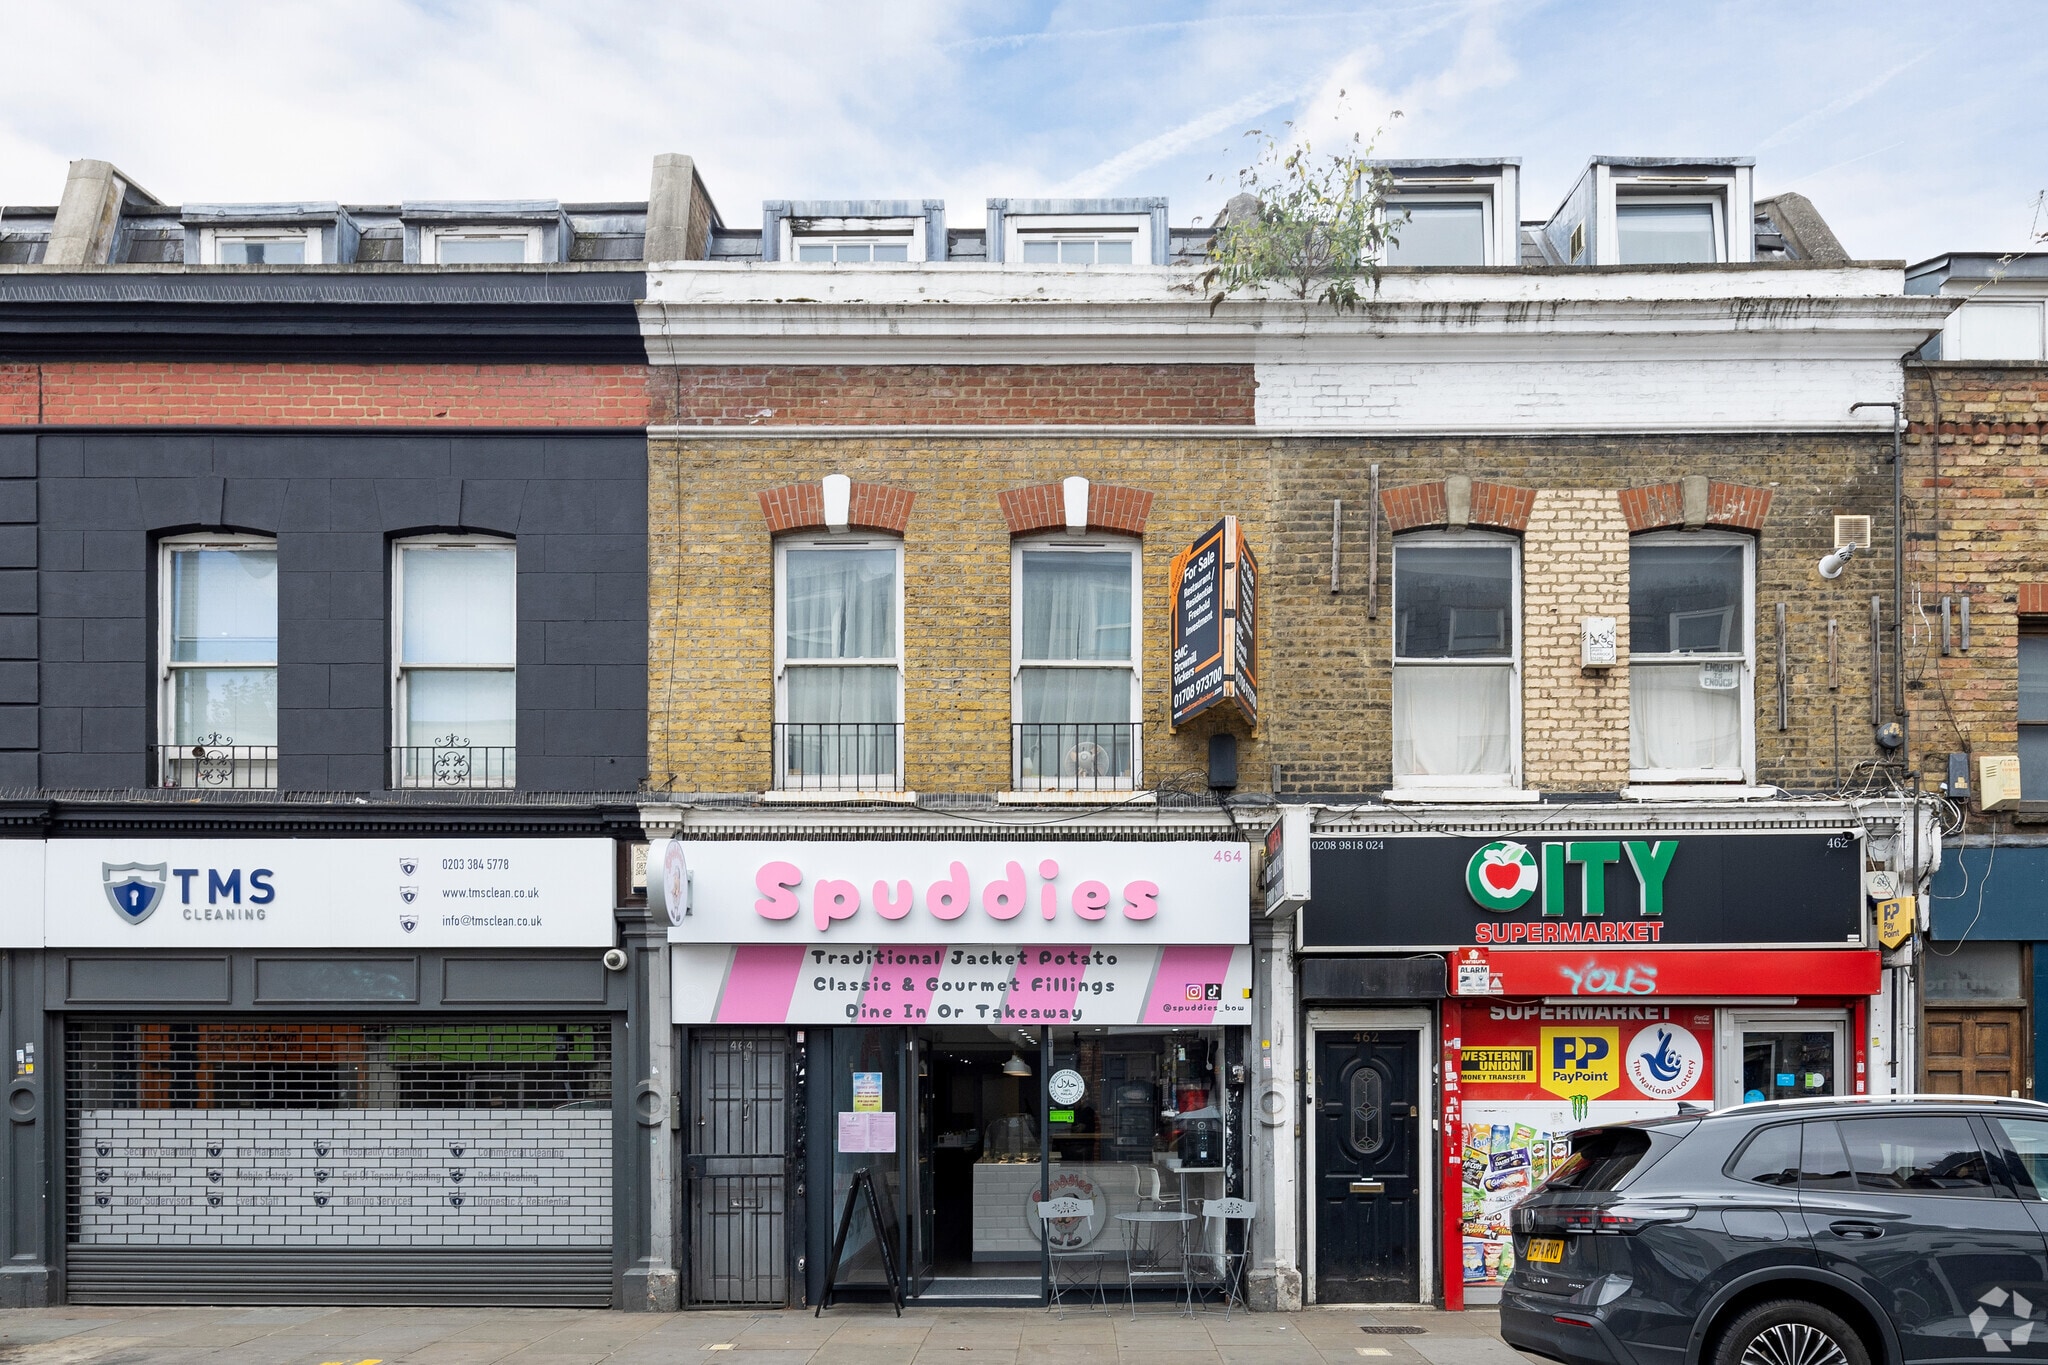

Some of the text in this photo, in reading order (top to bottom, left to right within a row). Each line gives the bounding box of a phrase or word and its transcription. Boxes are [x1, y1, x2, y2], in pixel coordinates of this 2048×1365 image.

[1184, 551, 1215, 584] For Sale
[1184, 571, 1211, 599] Restaurant
[1186, 582, 1213, 611] Residential
[1188, 597, 1211, 622] Freehold
[1186, 610, 1213, 637] Investment
[1174, 643, 1189, 662] SMC
[1174, 667, 1195, 687] Vickers
[1174, 683, 1195, 709] 01708
[1195, 665, 1222, 695] 973700
[1311, 840, 1384, 850] 0208 9818 024
[1826, 837, 1848, 849] 462
[1213, 850, 1243, 863] 464
[442, 858, 509, 870] 0203 384 5778
[1465, 840, 1680, 917] CITY
[172, 868, 276, 905] TMS
[442, 887, 540, 898] www.tmsclean.co.uk
[754, 858, 1160, 932] Spuddies
[183, 908, 267, 921] CLEANING
[442, 915, 543, 927] info@tmsclean.co.uk
[1475, 921, 1664, 944] SUPERMARKET
[1883, 921, 1895, 931] Pay
[1883, 930, 1900, 939] Point
[811, 949, 1118, 966] Traditional Jacket Potato
[1460, 966, 1487, 974] ALARM
[813, 977, 1116, 996] Classic & Gourmet Fillings
[845, 1003, 1083, 1023] Dine In Or Takeaway
[1163, 1003, 1245, 1013] @spuddies_bow
[1490, 1006, 1670, 1020] SUPERMARKET
[1353, 1031, 1380, 1042] 462
[1461, 1051, 1521, 1061] WESTERN
[1479, 1061, 1521, 1071] UNION
[1057, 1078, 1077, 1089] حلال
[1553, 1071, 1609, 1084] PayPoint
[1633, 1059, 1695, 1095] The National Lottery
[343, 1170, 357, 1181] End
[526, 1197, 570, 1206] Residentia
